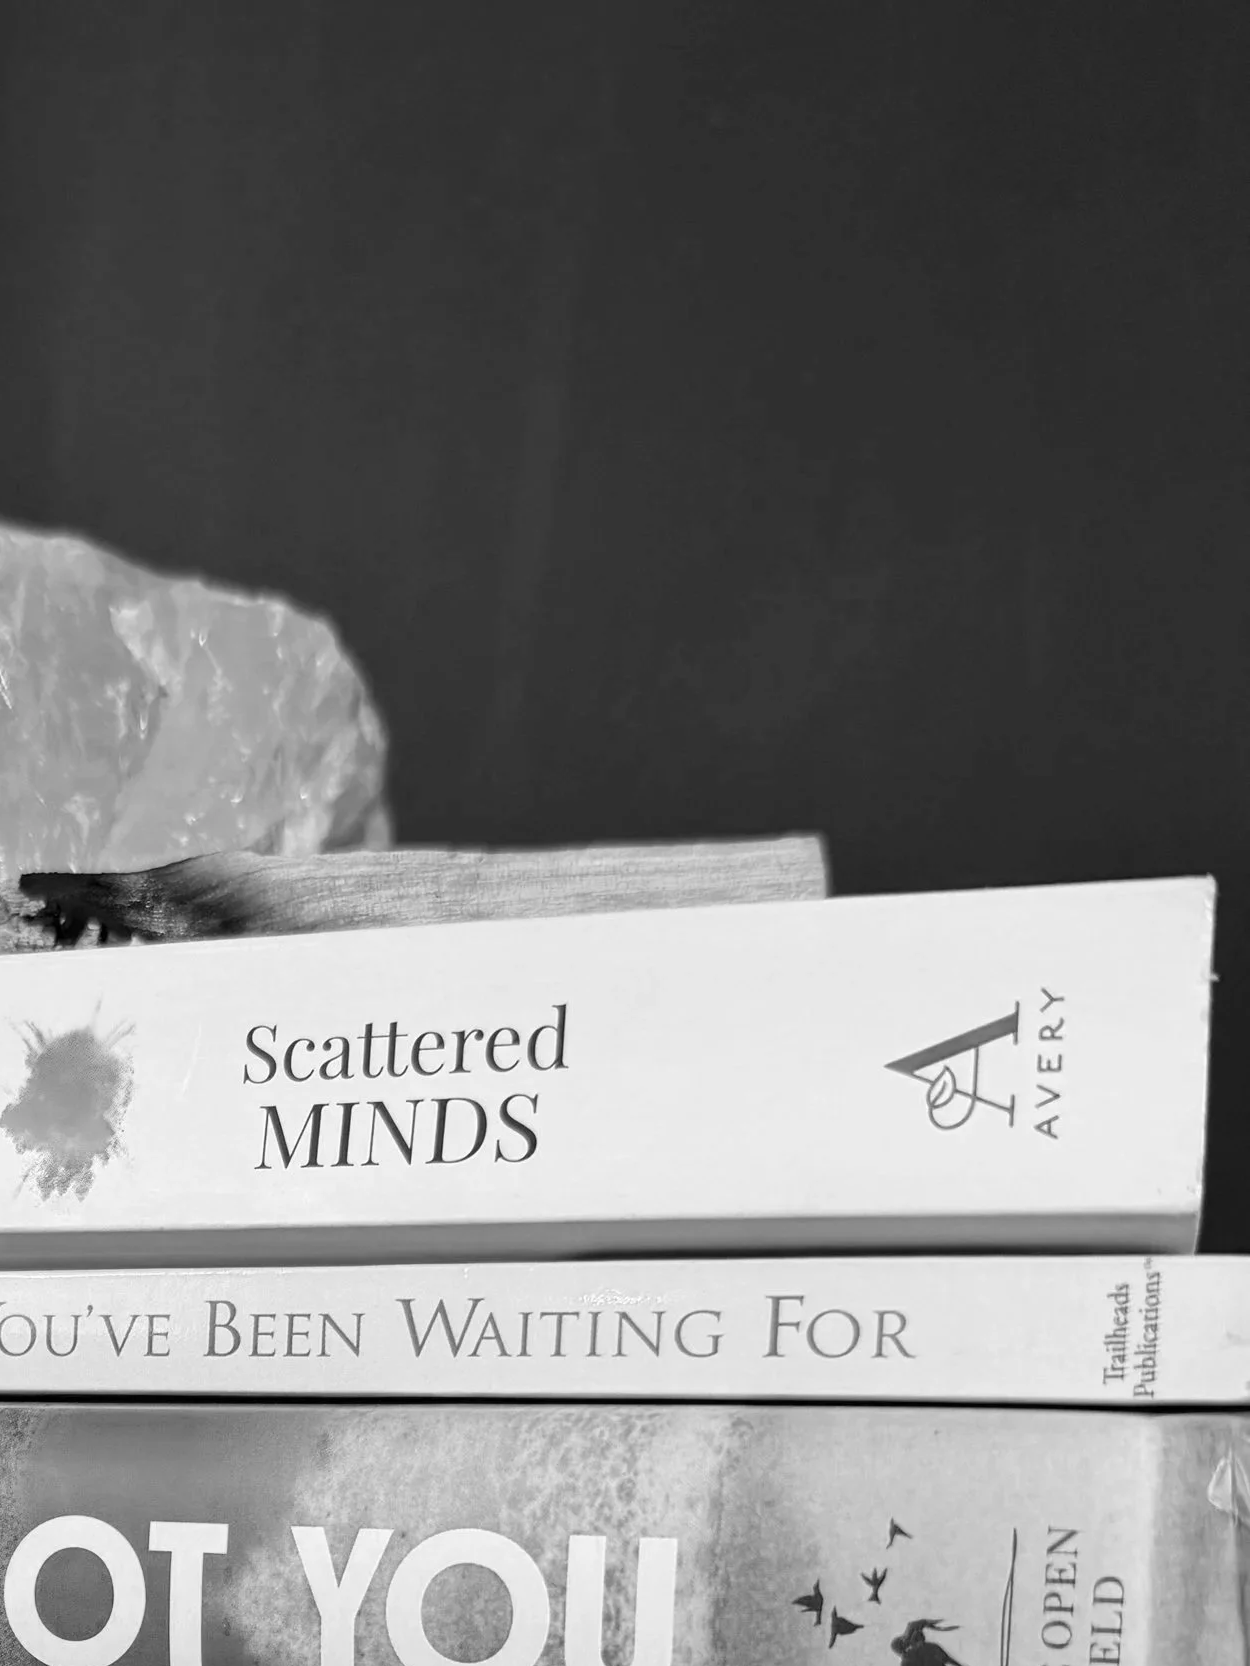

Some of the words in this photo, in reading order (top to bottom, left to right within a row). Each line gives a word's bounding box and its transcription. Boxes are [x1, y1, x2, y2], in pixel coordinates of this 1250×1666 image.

[242, 1004, 569, 1086] Scattered
[1034, 986, 1065, 1139] AVERY
[254, 1092, 540, 1170] MINDS
[1102, 1282, 1130, 1386] Trailheads
[1041, 1525, 1079, 1650] OPEN
